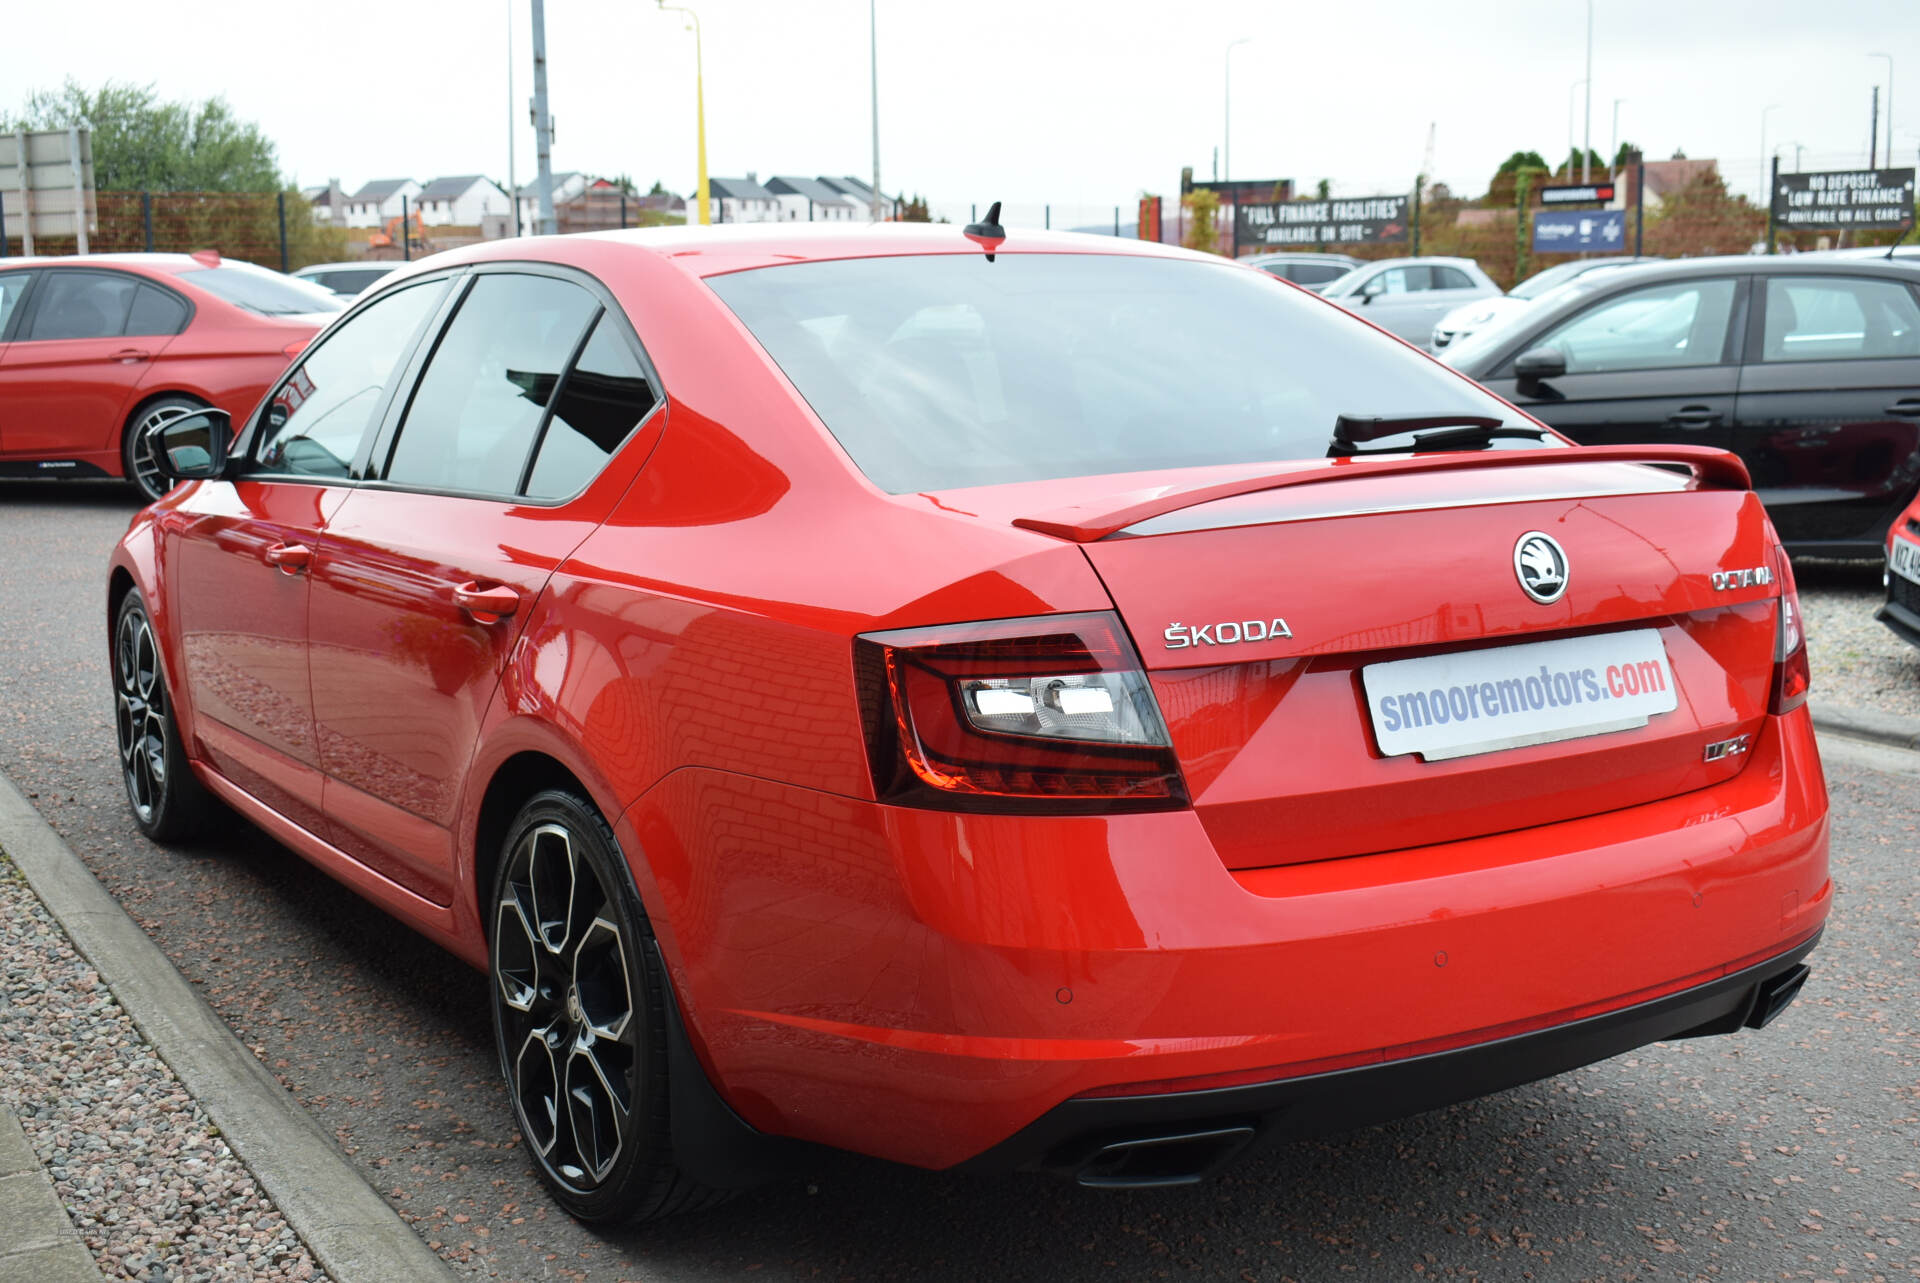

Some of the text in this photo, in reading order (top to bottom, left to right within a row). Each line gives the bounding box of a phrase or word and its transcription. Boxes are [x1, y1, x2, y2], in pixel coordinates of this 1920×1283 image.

[1808, 175, 1826, 191] NO
[1817, 189, 1848, 205] RATE
[1279, 203, 1329, 223] FINANCE
[1838, 209, 1853, 222] ON
[1854, 208, 1872, 222] ALL
[1320, 225, 1336, 241] ON
[1163, 618, 1293, 649] ŠKODA
[1380, 659, 1667, 732] smooremotors.com
